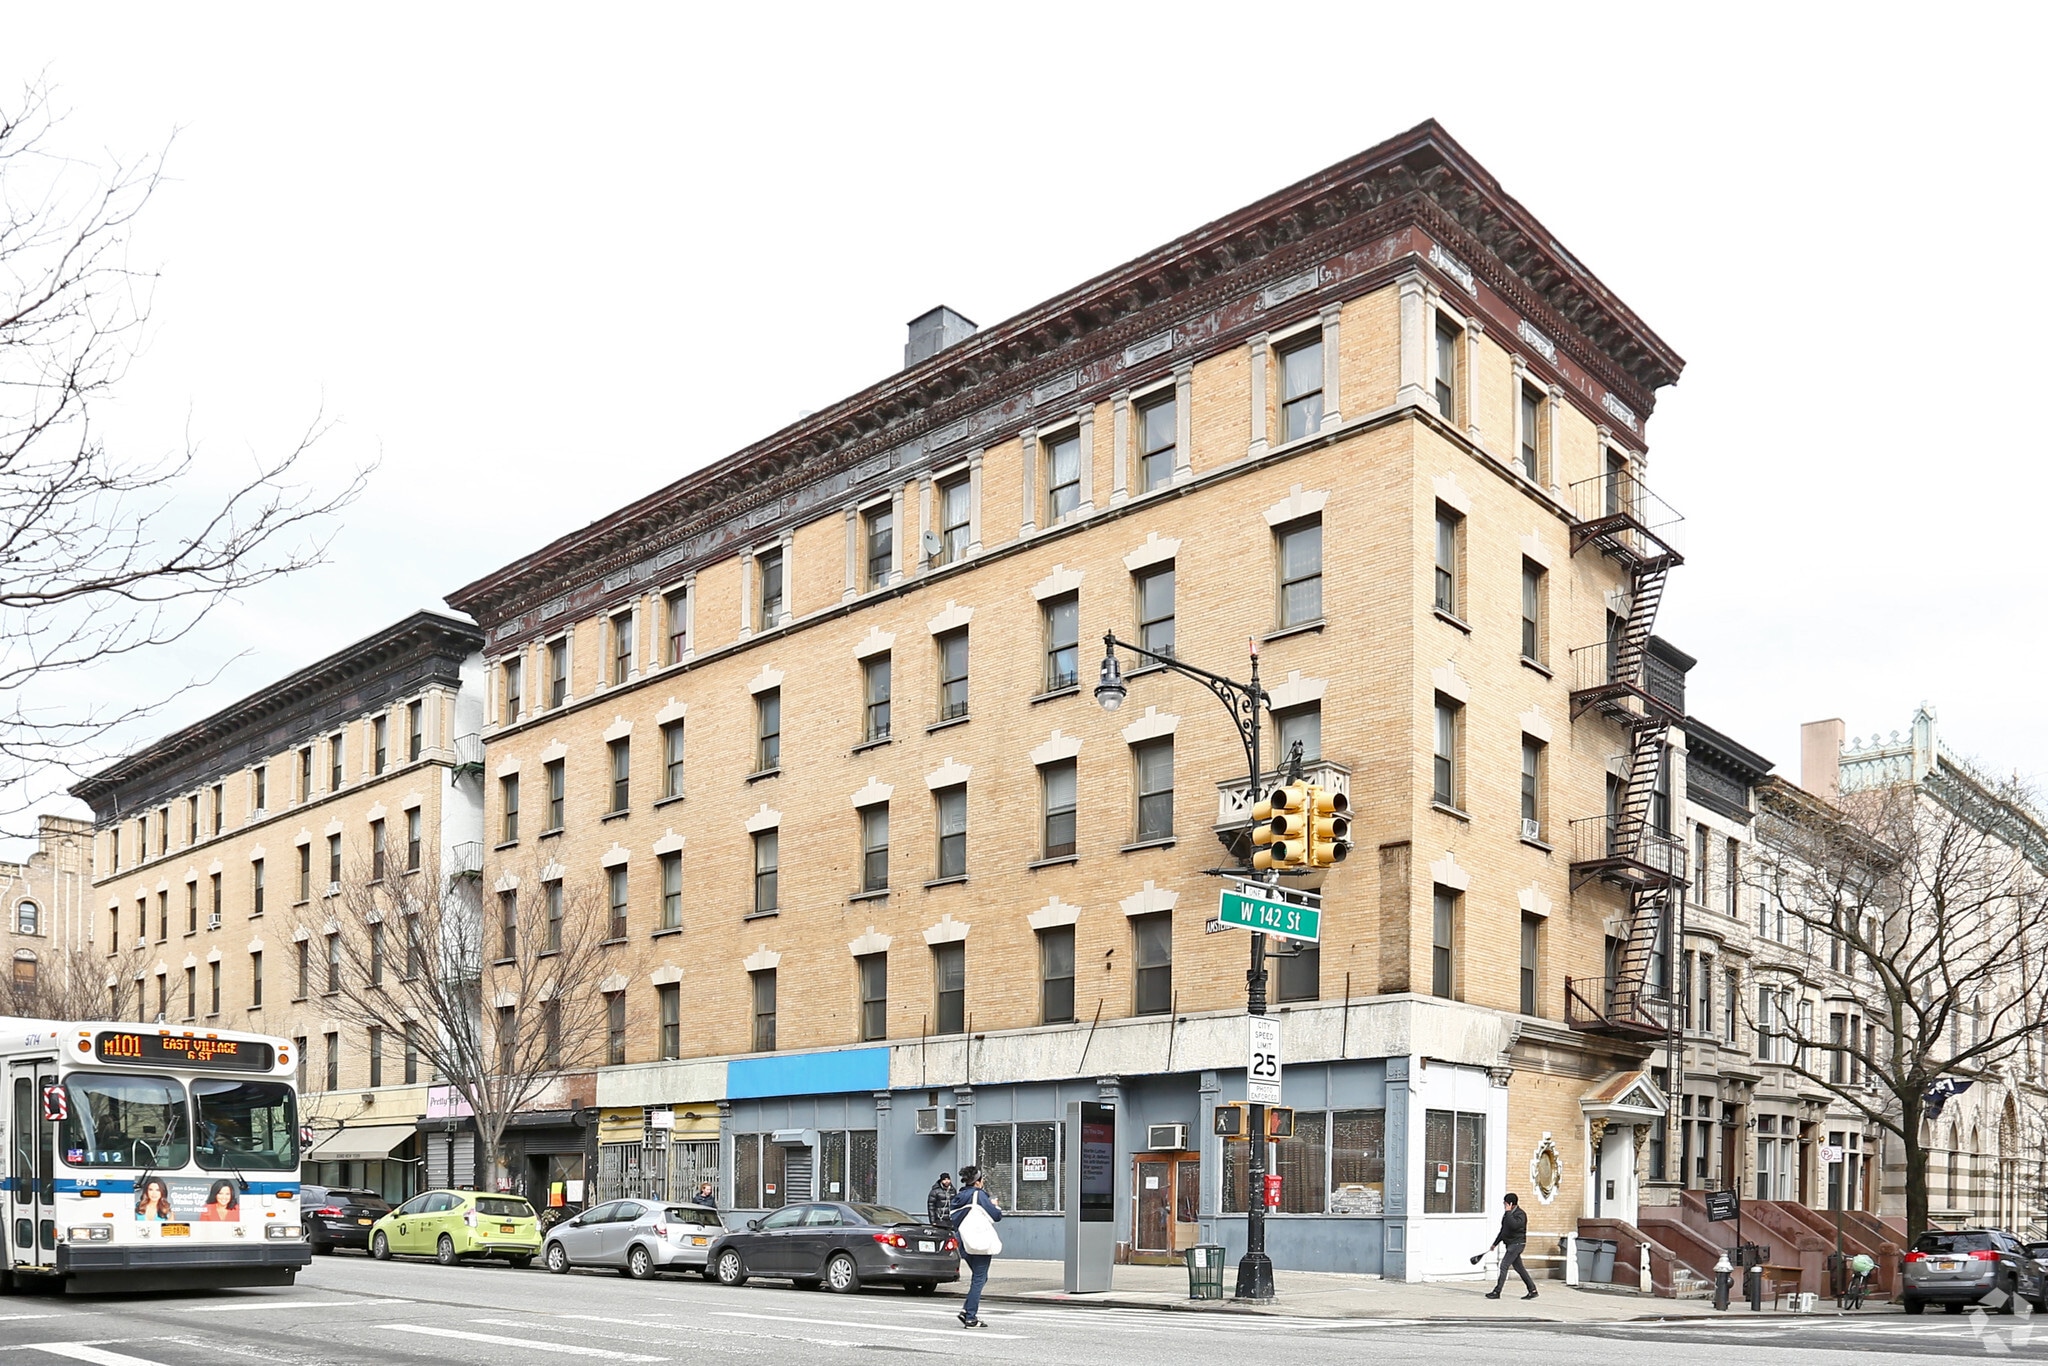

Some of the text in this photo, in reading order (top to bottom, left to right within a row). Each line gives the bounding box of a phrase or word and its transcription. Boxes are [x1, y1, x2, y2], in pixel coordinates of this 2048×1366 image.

[1241, 901, 1301, 931] W 142 St
[1257, 1021, 1271, 1030] CITY
[1255, 1031, 1274, 1040] SPEED
[104, 1035, 237, 1057] M101 EAST VILLAGE
[1257, 1042, 1272, 1050] LIMIT
[187, 1051, 213, 1061] 6 ST
[1253, 1052, 1277, 1077] 25
[1256, 1086, 1273, 1094] PHOTO
[1251, 1092, 1278, 1101] ENFORCED
[76, 1179, 97, 1187] 5714
[193, 1192, 209, 1201] Day
